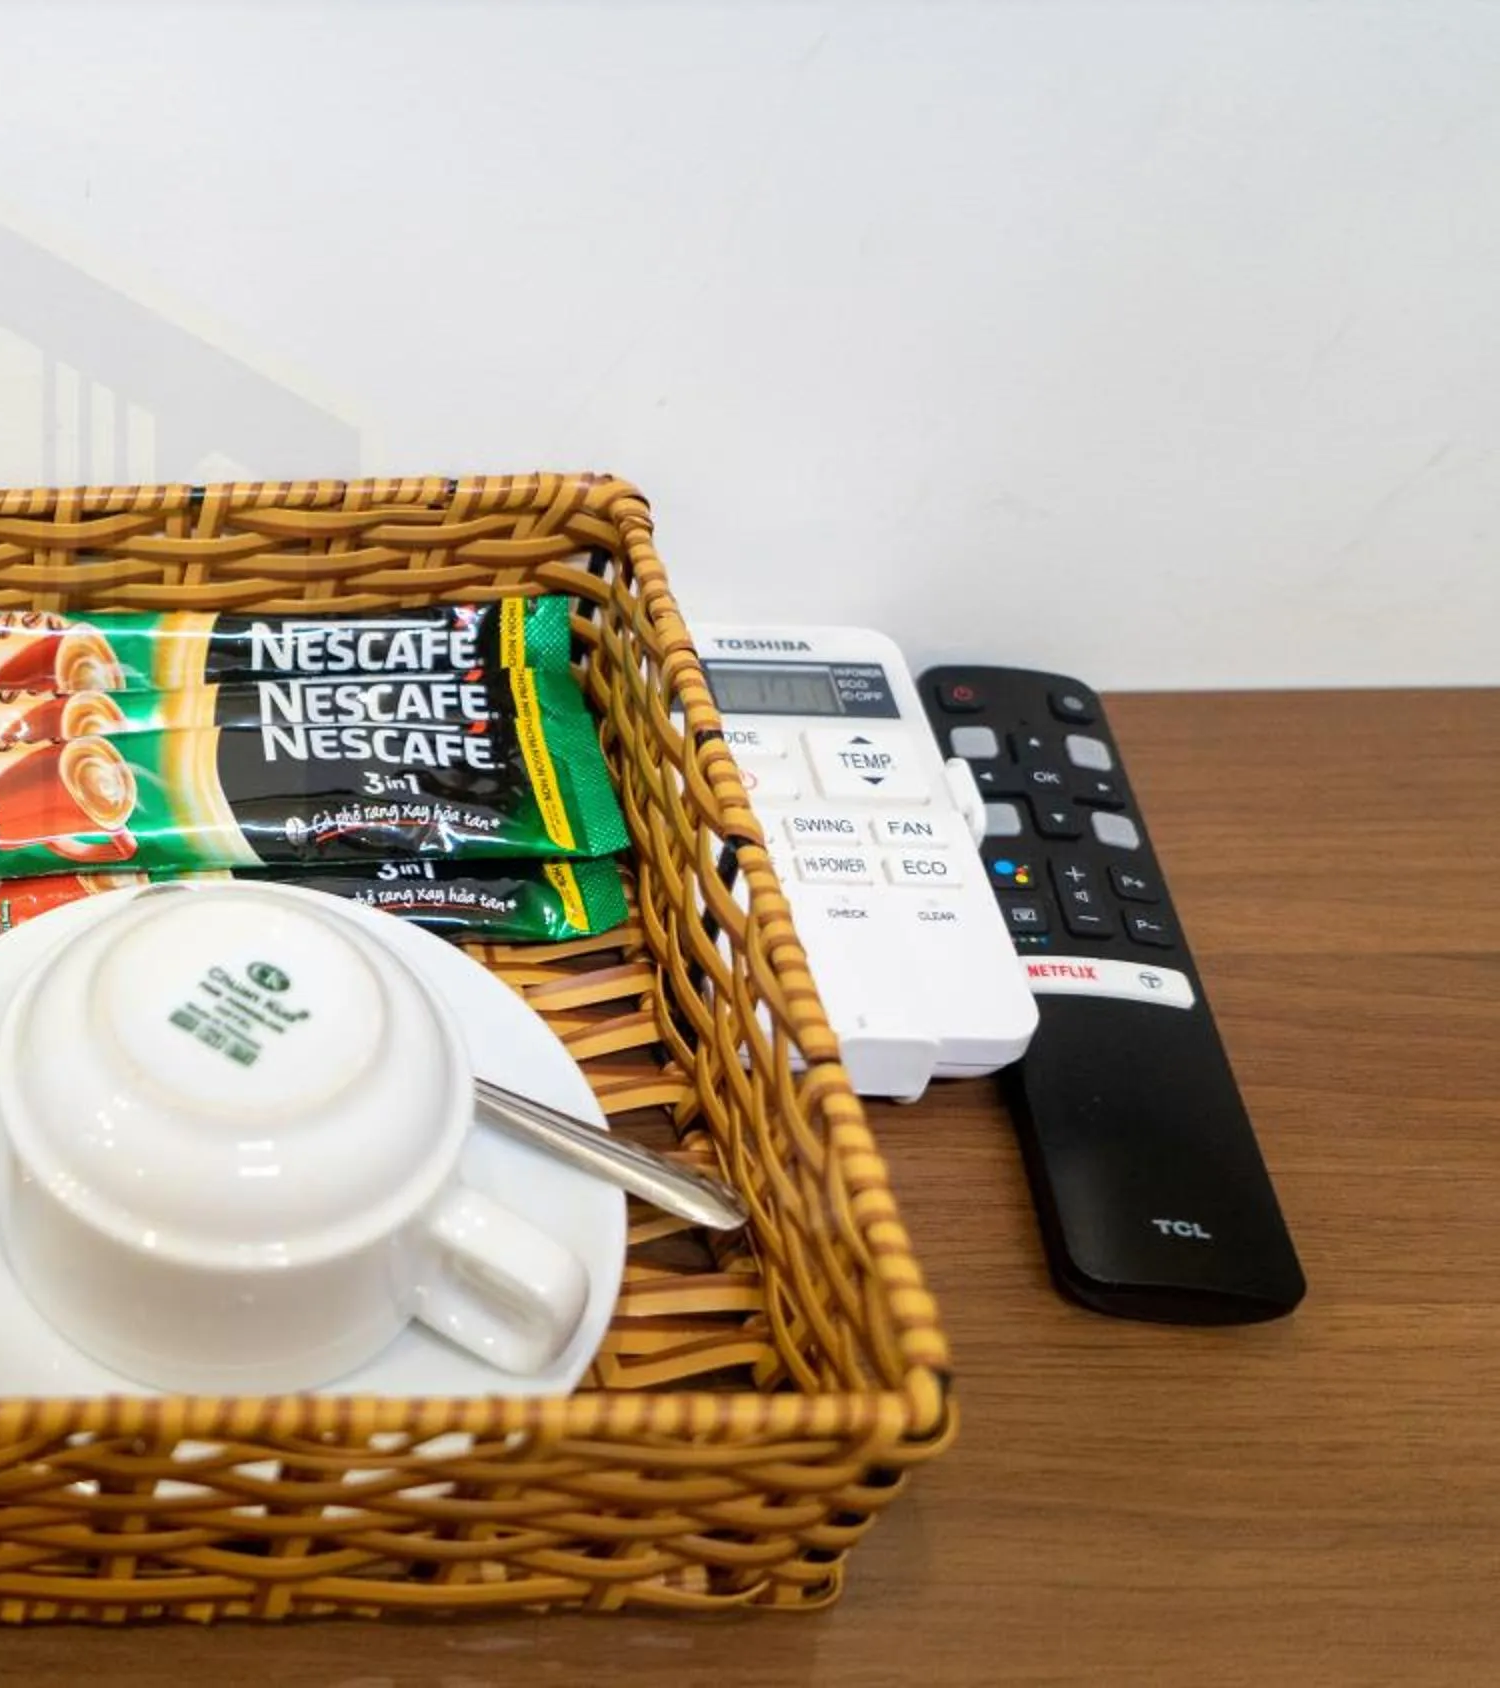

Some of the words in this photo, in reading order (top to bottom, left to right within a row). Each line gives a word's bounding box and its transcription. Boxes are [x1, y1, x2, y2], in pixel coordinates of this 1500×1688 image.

[713, 638, 812, 651] TOSHIBA
[724, 730, 760, 745] ODE
[1033, 771, 1061, 784] OK
[364, 803, 399, 824] rang
[793, 817, 855, 834] SWING
[887, 821, 933, 836] FAN
[902, 859, 948, 876] ECO
[378, 888, 414, 908] rang
[416, 887, 445, 905] xay
[826, 908, 869, 919] CHECK
[917, 911, 957, 922] CLEAR
[1026, 964, 1099, 981] NETFLIX
[1150, 1218, 1213, 1240] TCL
